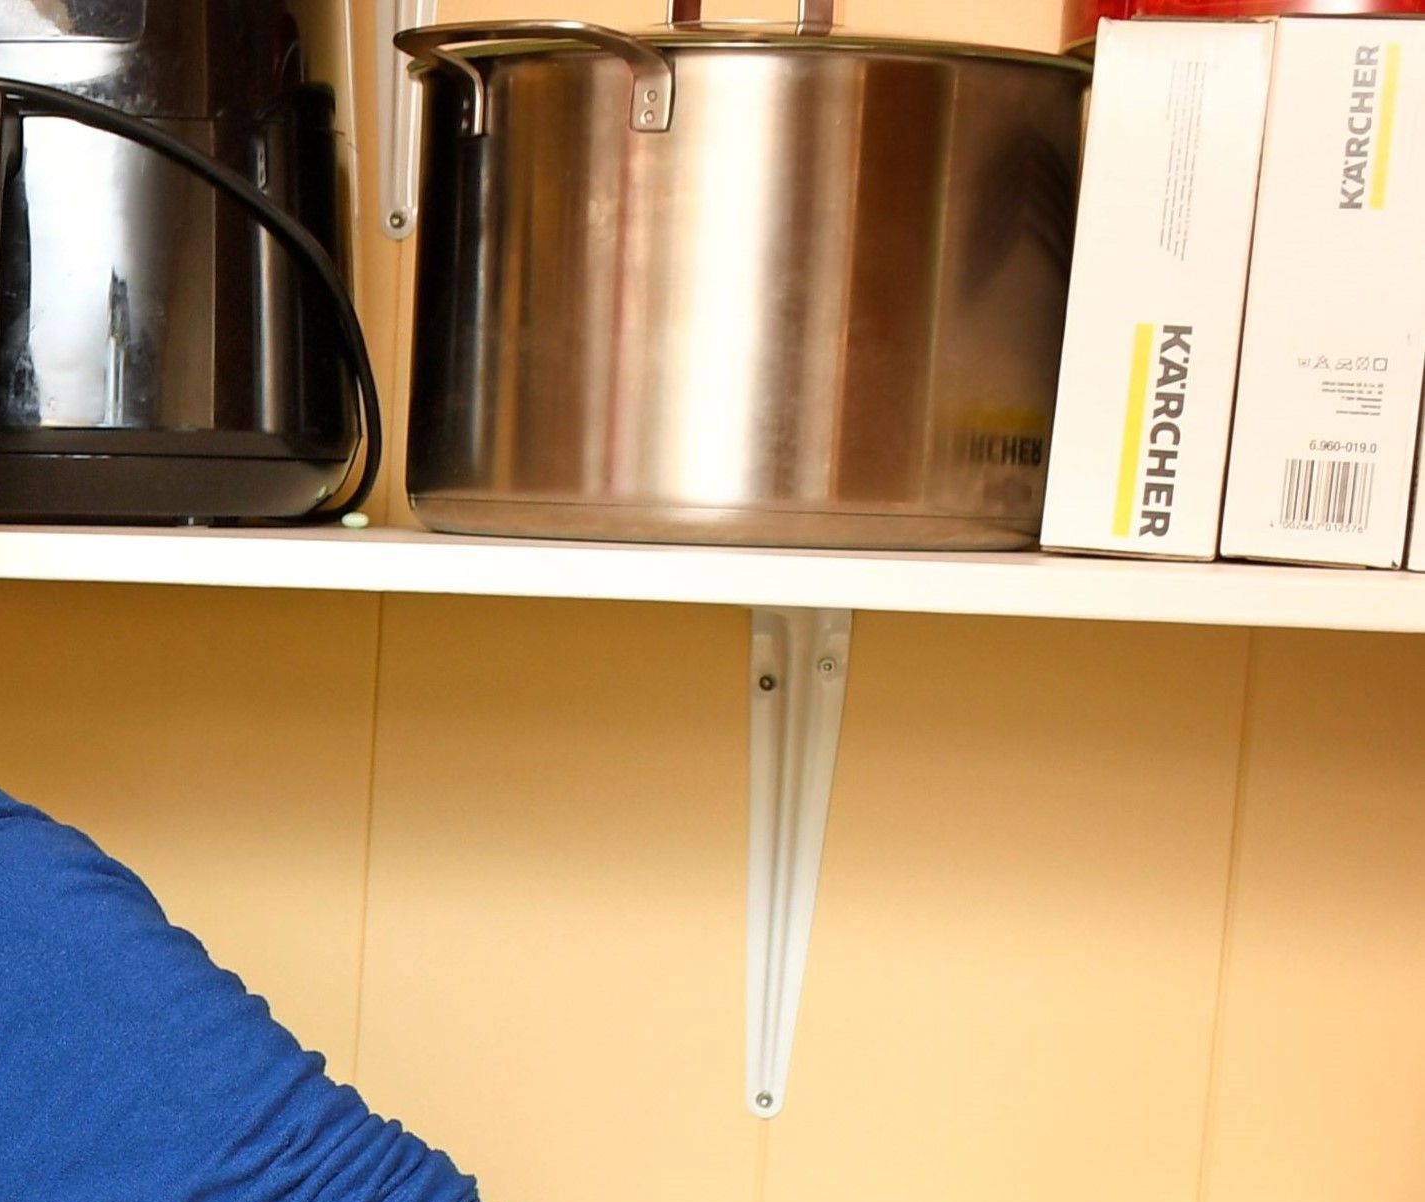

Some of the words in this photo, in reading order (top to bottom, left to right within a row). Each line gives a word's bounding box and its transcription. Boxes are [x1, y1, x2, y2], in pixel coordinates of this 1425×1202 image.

[1338, 44, 1381, 211] KÄRCHER
[1139, 324, 1194, 538] KÄRCHER
[1309, 440, 1377, 453] 6.960-019.0
